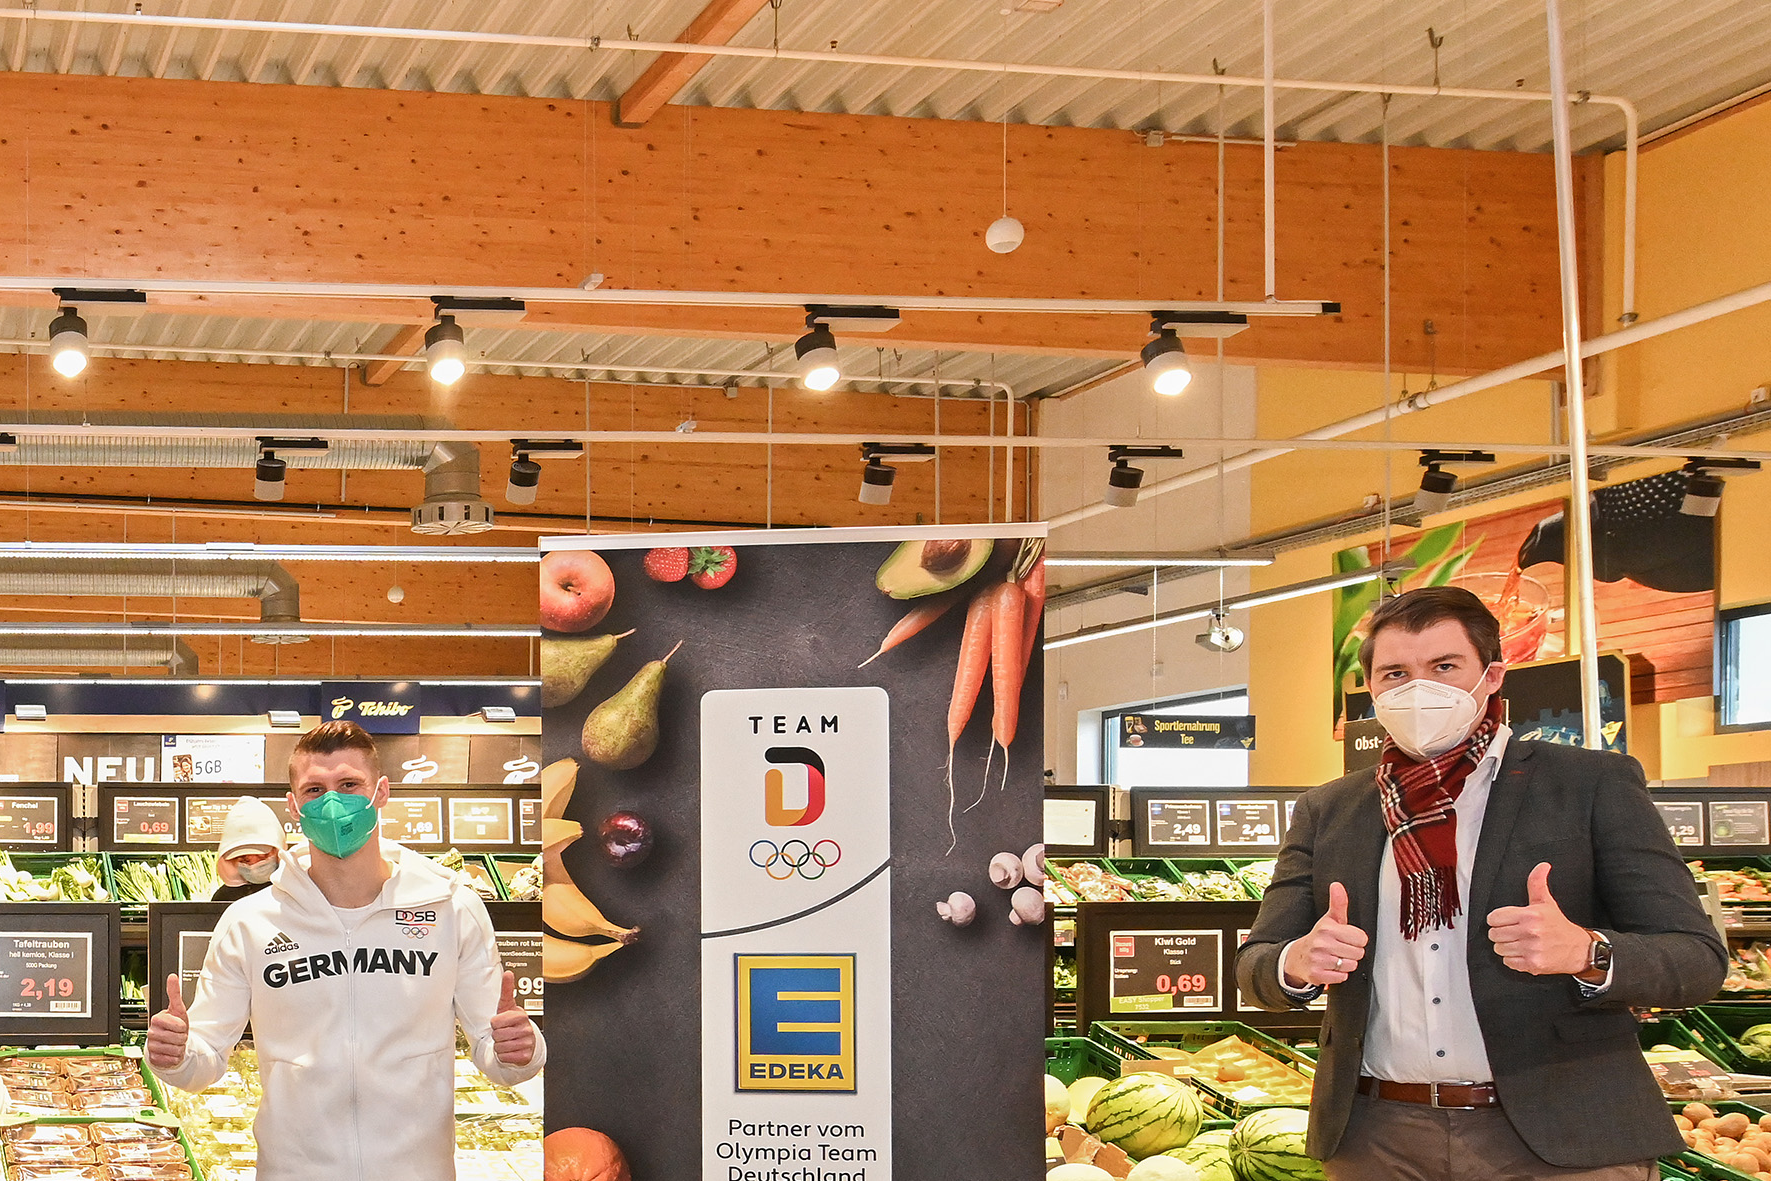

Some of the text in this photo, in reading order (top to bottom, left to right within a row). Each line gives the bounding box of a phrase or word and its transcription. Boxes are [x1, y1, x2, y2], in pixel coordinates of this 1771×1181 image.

[358, 702, 414, 716] Tchibo
[748, 716, 839, 734] TEAM
[1154, 720, 1220, 733] Sportlernahrung
[1180, 734, 1194, 744] Tee
[24, 822, 54, 835] 1,99
[140, 822, 169, 834] 0,69
[1174, 824, 1201, 836] 2,49
[396, 910, 436, 922] DOSB
[14, 940, 69, 948] Tafeltrauben
[264, 942, 299, 955] adidas
[1155, 938, 1196, 946] Kiwi Gold
[263, 948, 438, 988] GERMANY
[20, 978, 73, 1000] 2,19
[1156, 974, 1206, 996] 0,69
[749, 1063, 844, 1080] EDEKA
[728, 1118, 865, 1138] Partner vom
[716, 1143, 877, 1163] Olympia Team
